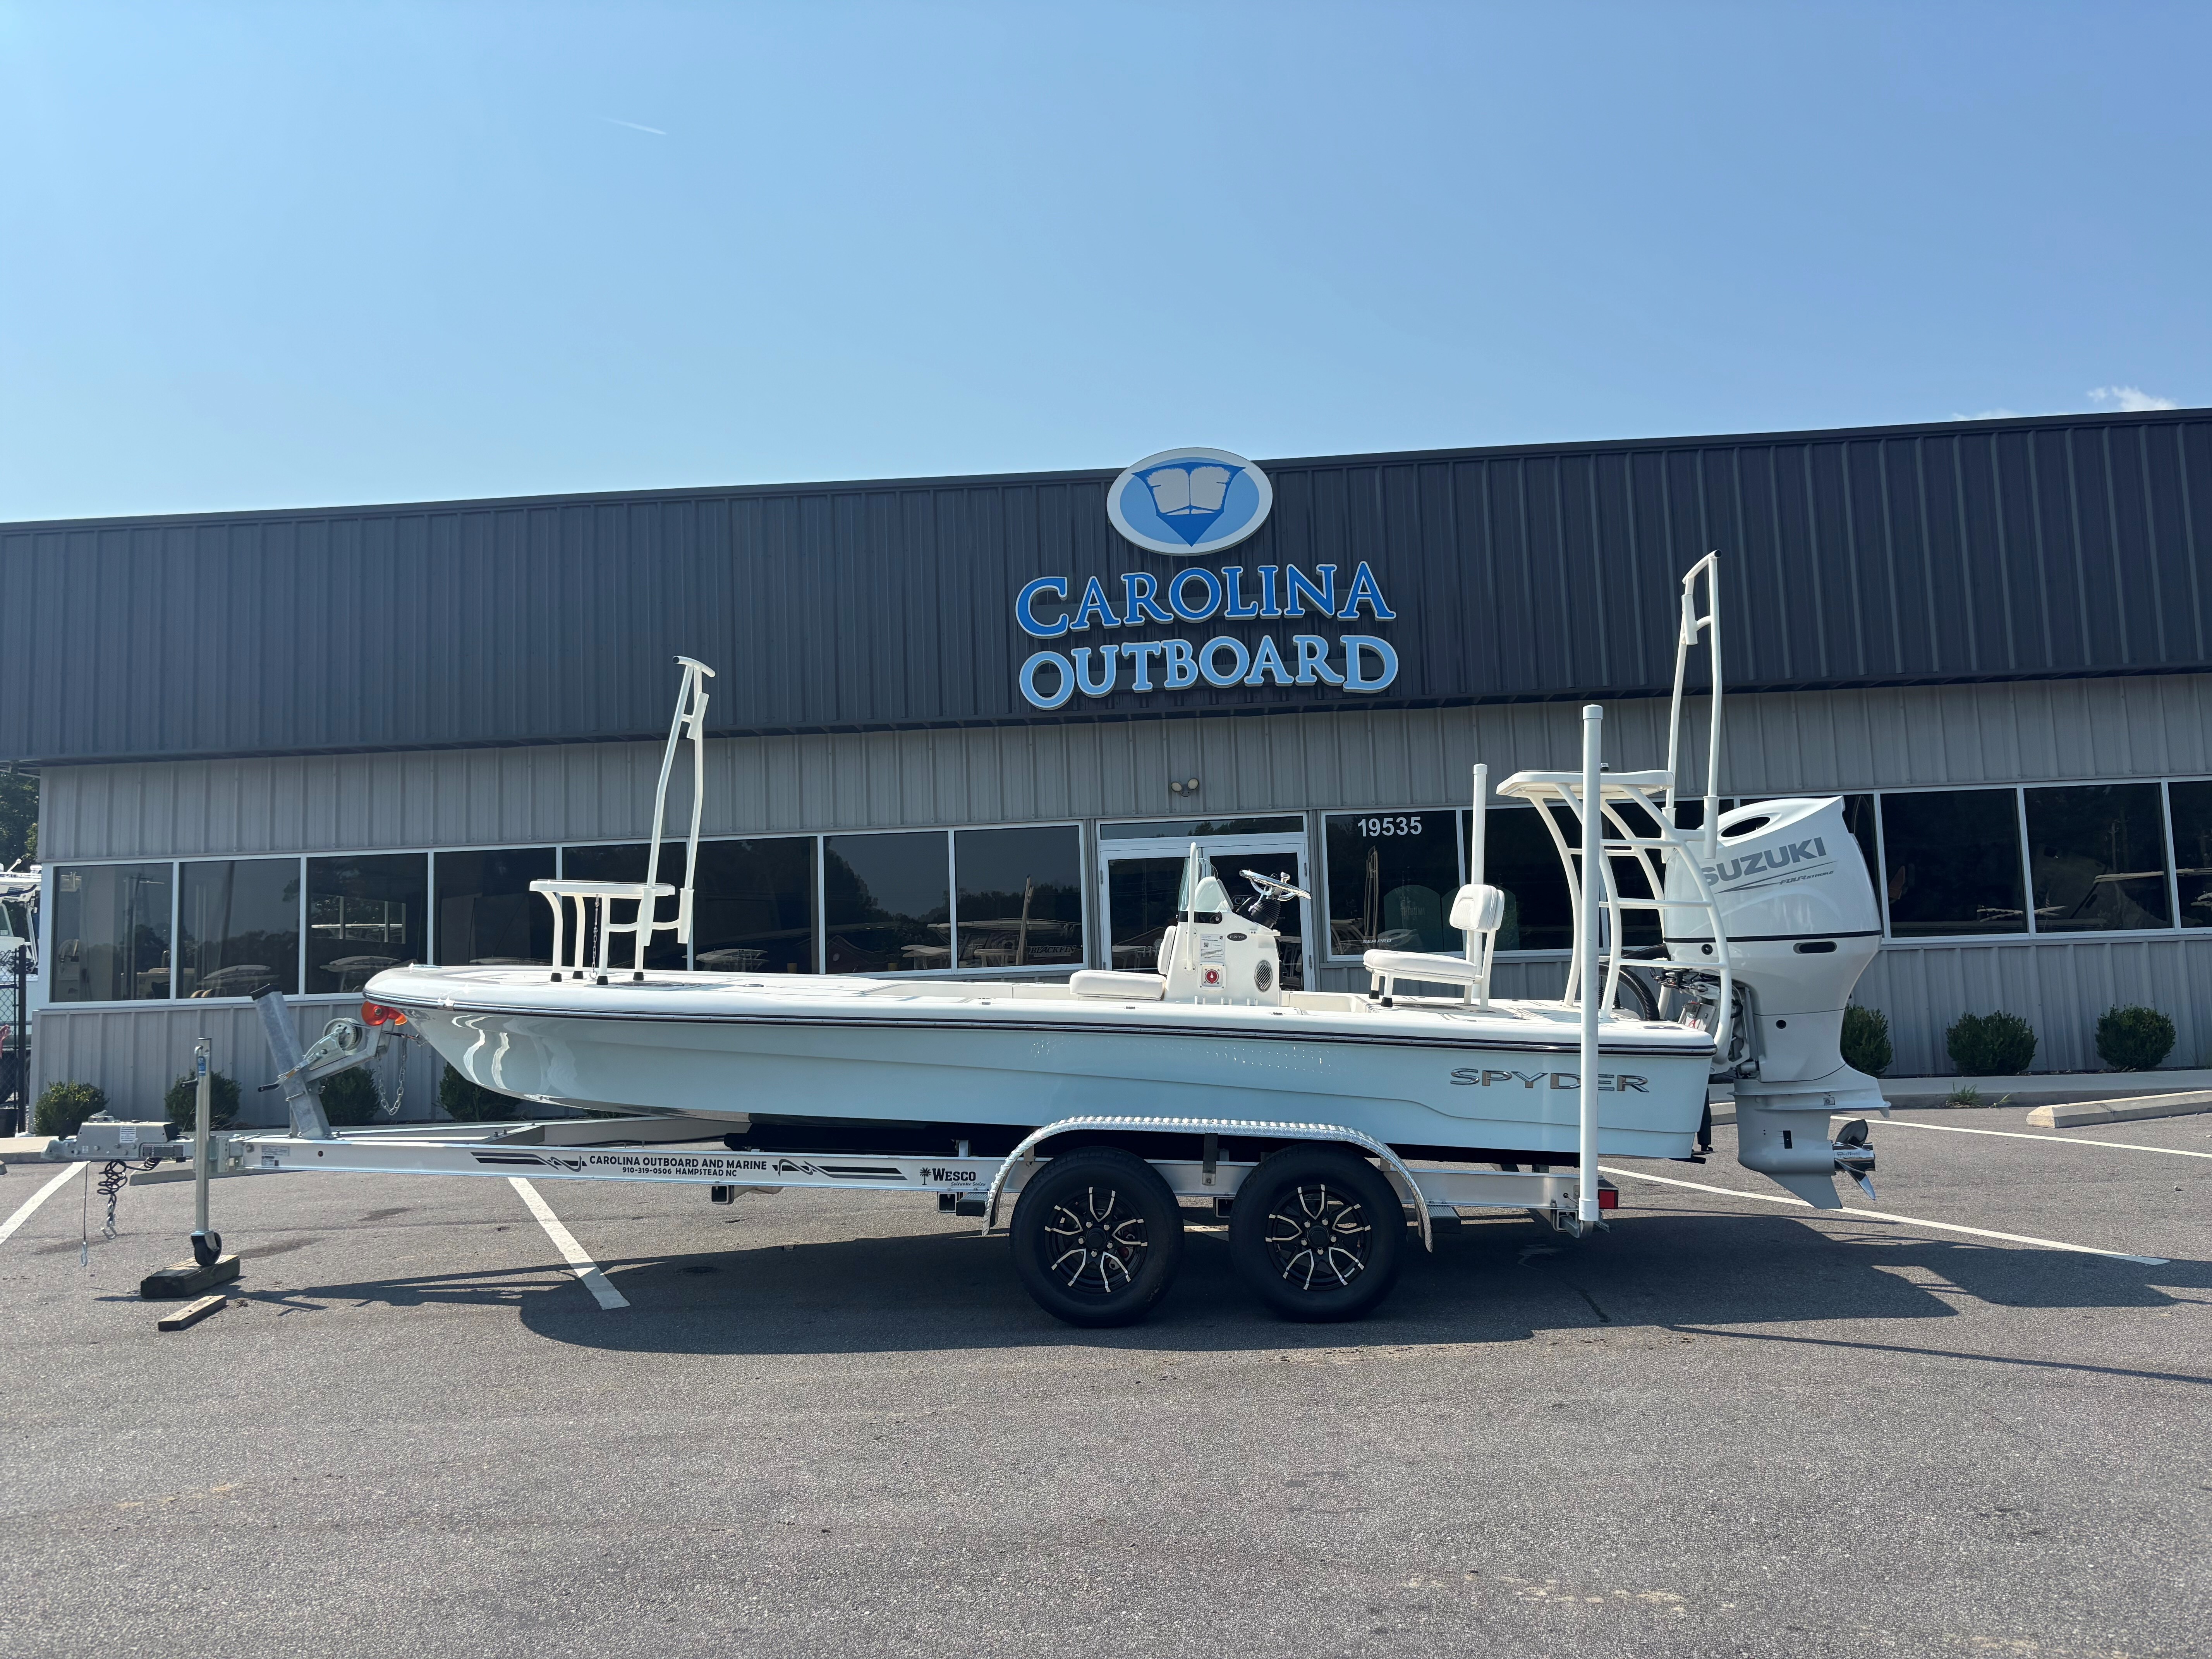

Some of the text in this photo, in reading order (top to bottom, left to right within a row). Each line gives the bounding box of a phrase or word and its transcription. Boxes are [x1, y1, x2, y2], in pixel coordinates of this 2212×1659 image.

[1016, 561, 1396, 639] CAROLINA
[1019, 635, 1399, 710] OUTBOARD
[1358, 816, 1422, 837] 19535
[1701, 837, 1826, 886] SUZUKI
[1450, 1068, 1649, 1092] SPYDER
[589, 1156, 767, 1170] CAROLINA OUTBOARD AND MARINE
[676, 1168, 724, 1176] HAMPSTEAD
